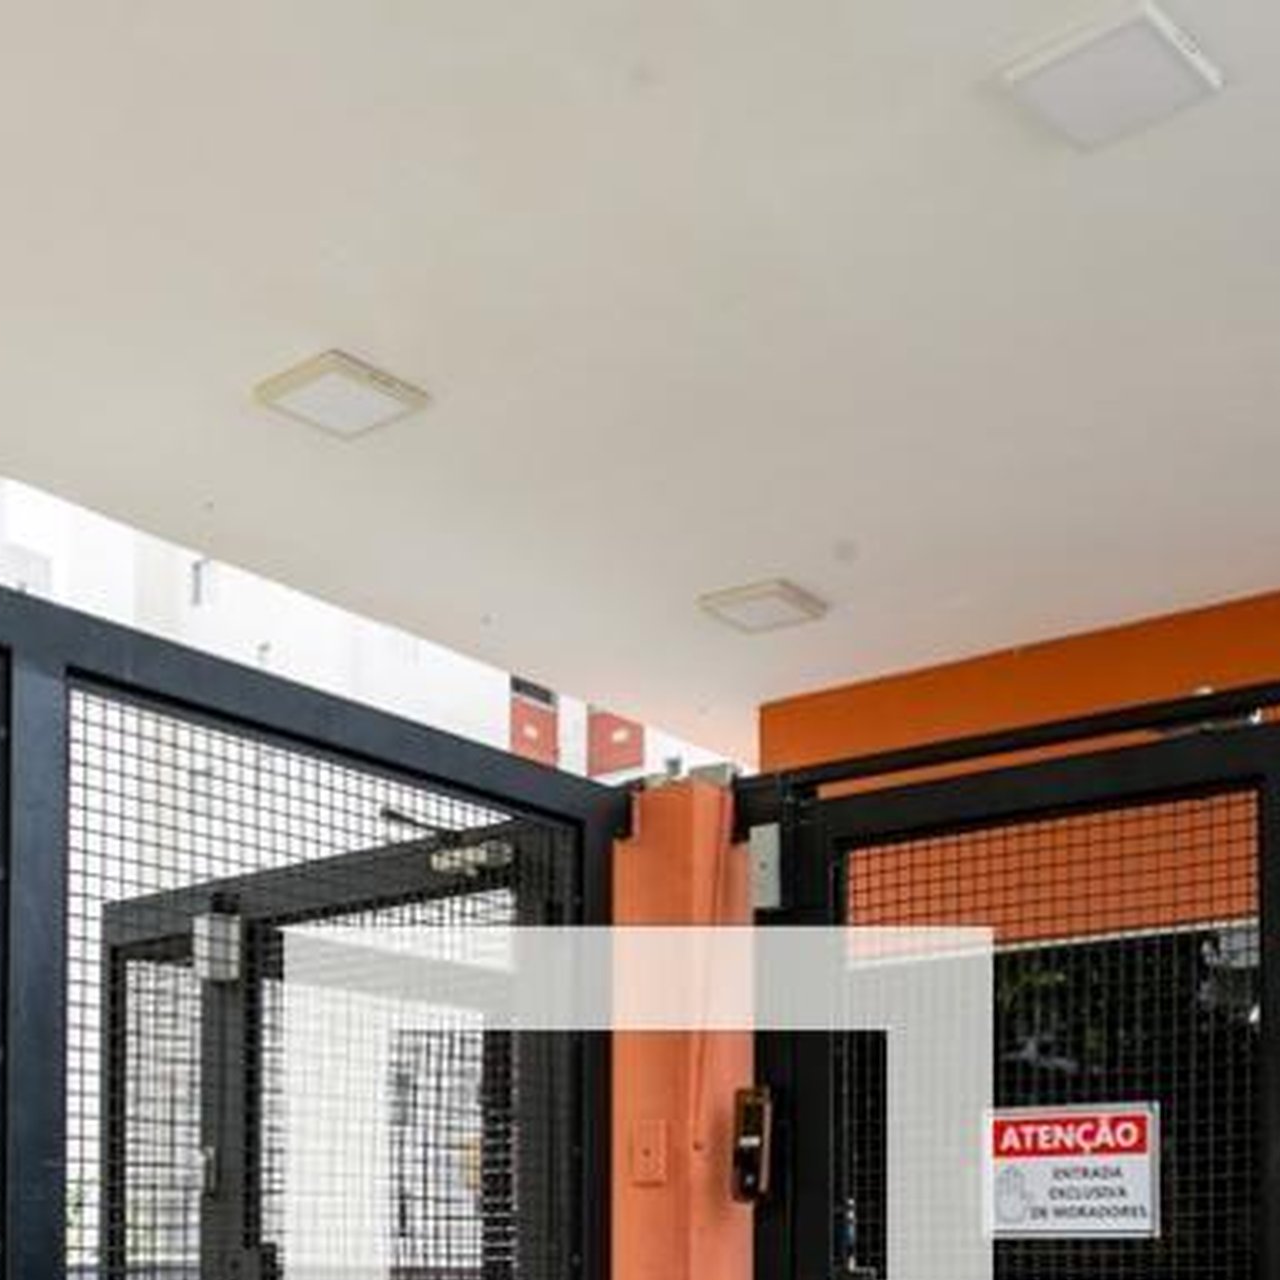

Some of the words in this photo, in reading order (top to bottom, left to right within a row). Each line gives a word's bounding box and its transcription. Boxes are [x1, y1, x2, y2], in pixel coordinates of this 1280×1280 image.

[1001, 1117, 1139, 1153] ATENÇÃO
[1052, 1165, 1123, 1180] ENTRADA
[1048, 1186, 1127, 1201] EXCLUSIVA
[1030, 1206, 1047, 1220] DE
[1052, 1203, 1147, 1219] MORADORES
